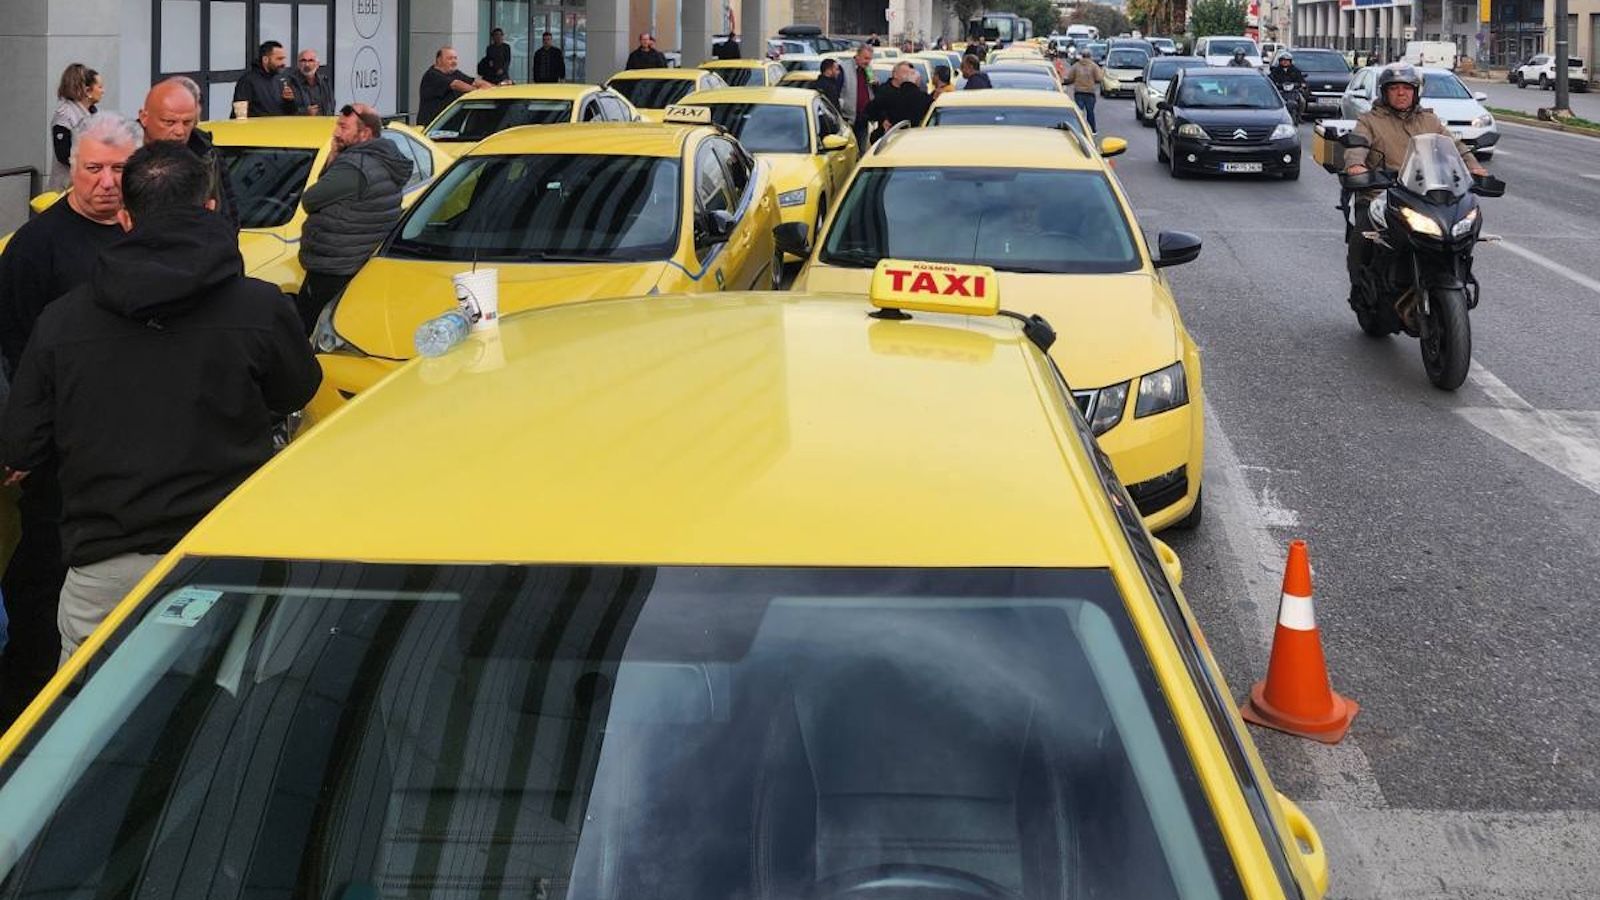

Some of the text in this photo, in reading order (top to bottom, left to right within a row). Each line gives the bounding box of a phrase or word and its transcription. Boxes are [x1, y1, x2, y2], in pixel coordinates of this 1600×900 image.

[355, 69, 378, 89] NLG
[667, 106, 705, 117] TAXI
[885, 269, 985, 298] TAXI
